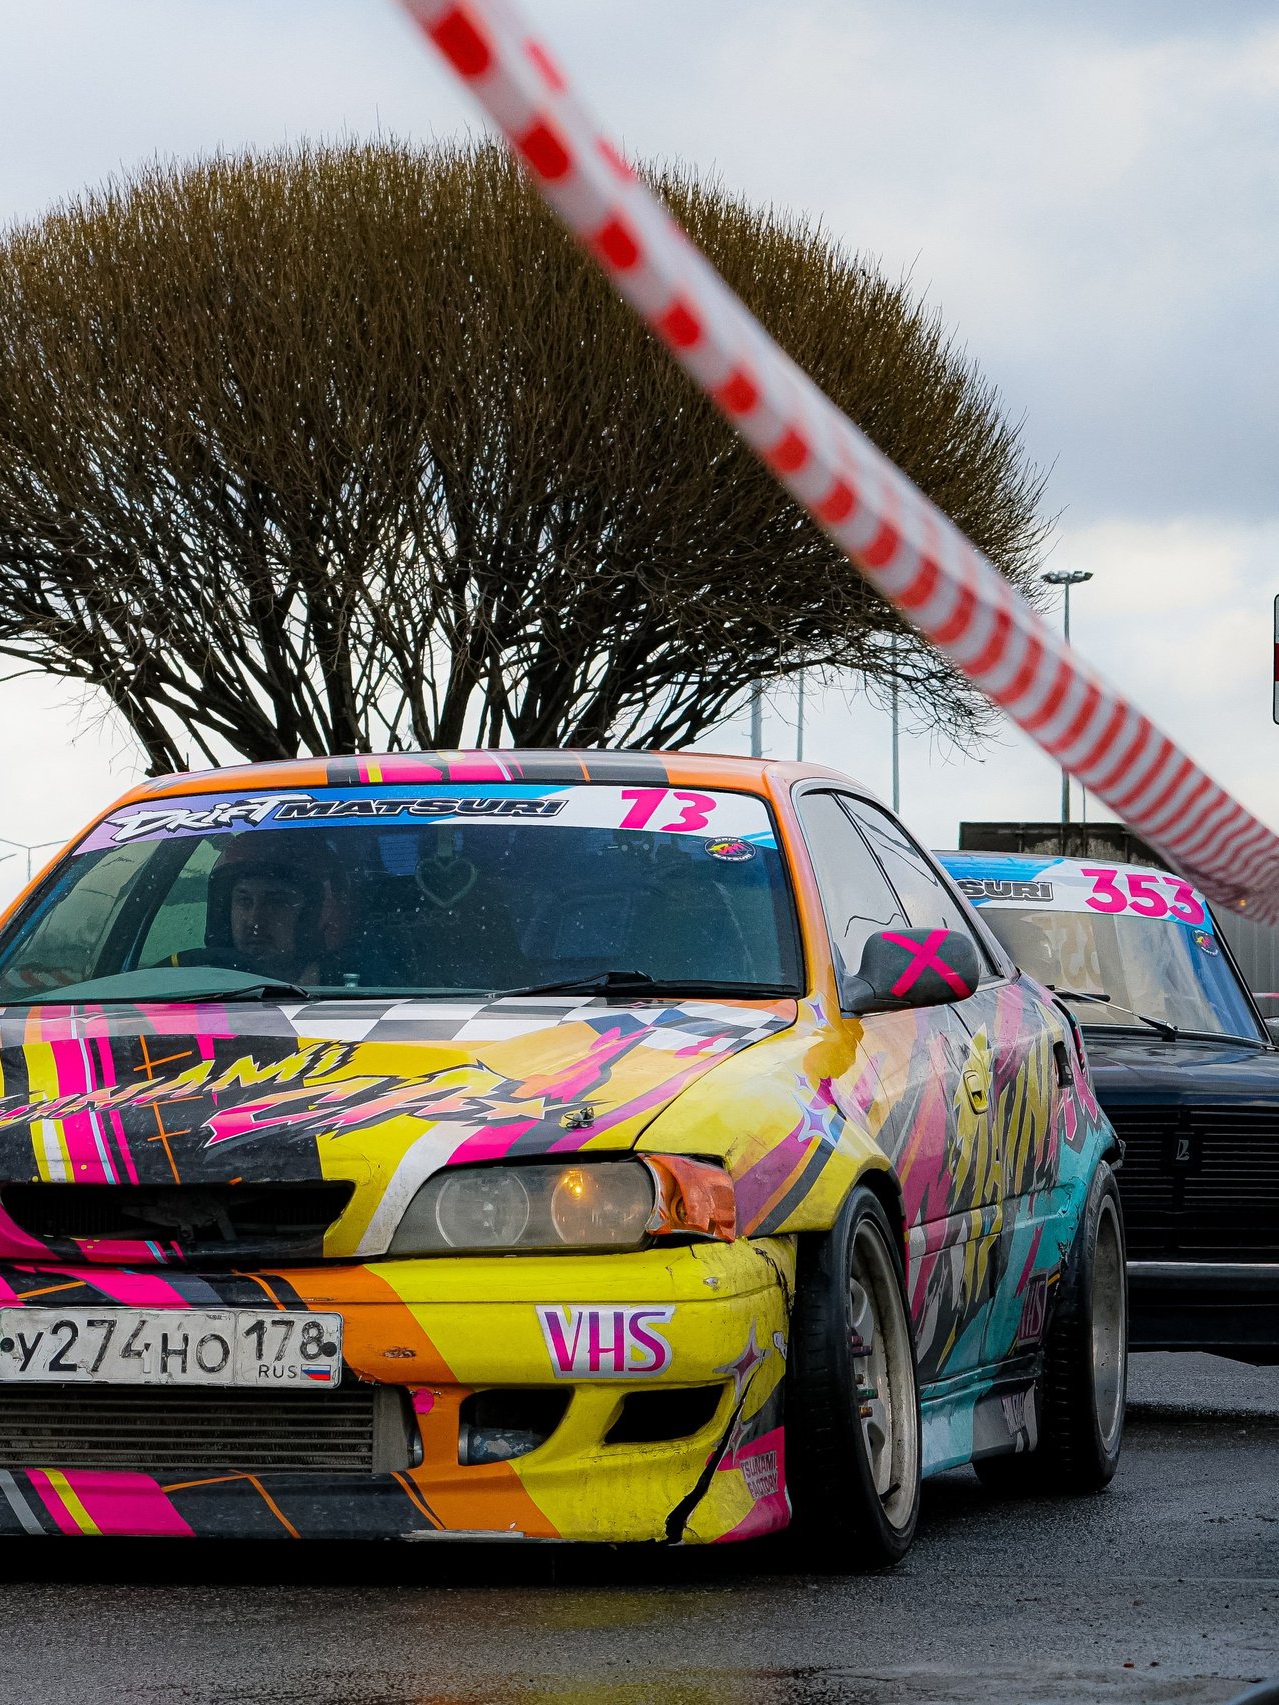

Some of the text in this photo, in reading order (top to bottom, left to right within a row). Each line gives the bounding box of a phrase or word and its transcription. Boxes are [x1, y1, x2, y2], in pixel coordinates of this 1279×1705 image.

[273, 797, 570, 820] MATSURI
[619, 789, 717, 831] 73
[954, 868, 1205, 925] SURI 353
[242, 1319, 326, 1362] 178
[539, 1308, 671, 1376] VHS
[257, 1364, 298, 1380] RUS
[740, 1450, 777, 1480] TSUNAMI
[747, 1472, 779, 1500] FACTORY
